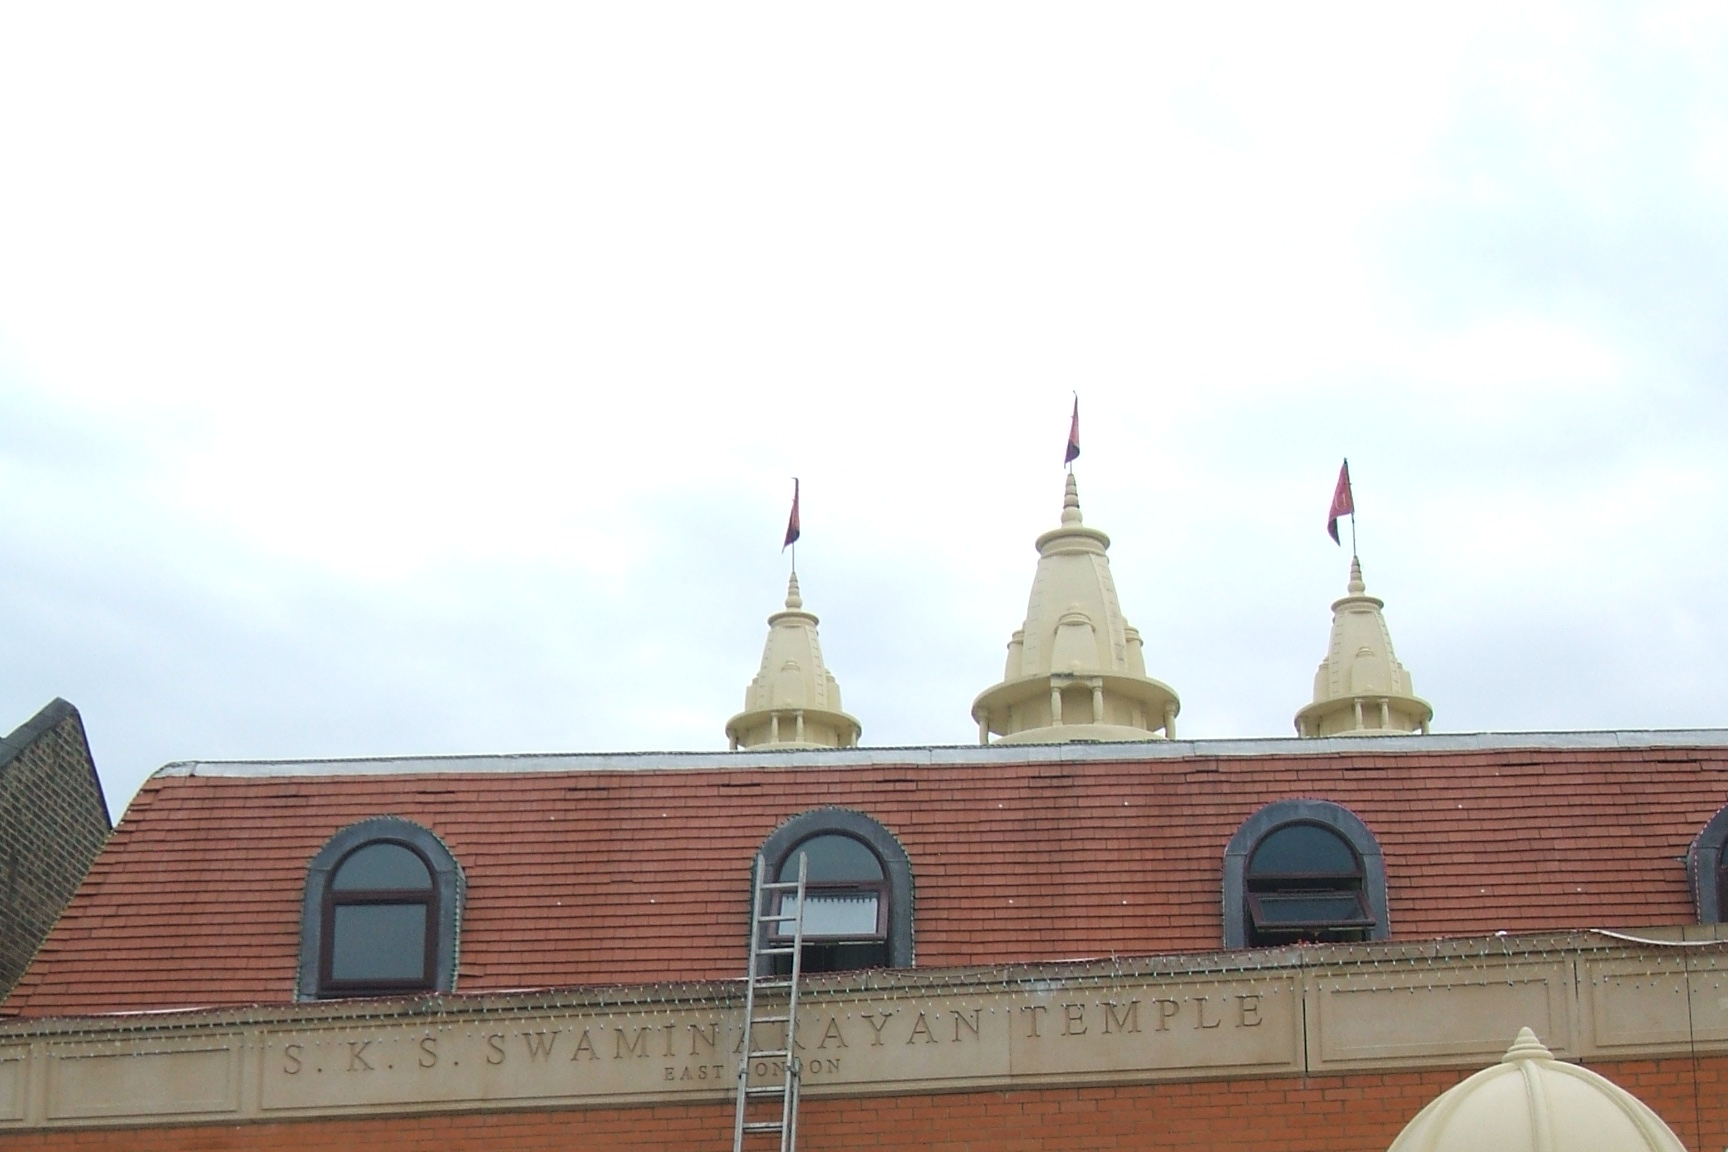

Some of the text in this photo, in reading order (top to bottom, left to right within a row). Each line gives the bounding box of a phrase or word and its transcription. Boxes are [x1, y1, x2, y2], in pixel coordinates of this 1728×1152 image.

[1023, 995, 1263, 1038] TEMPLE
[664, 1058, 841, 1081] EAST ONON
